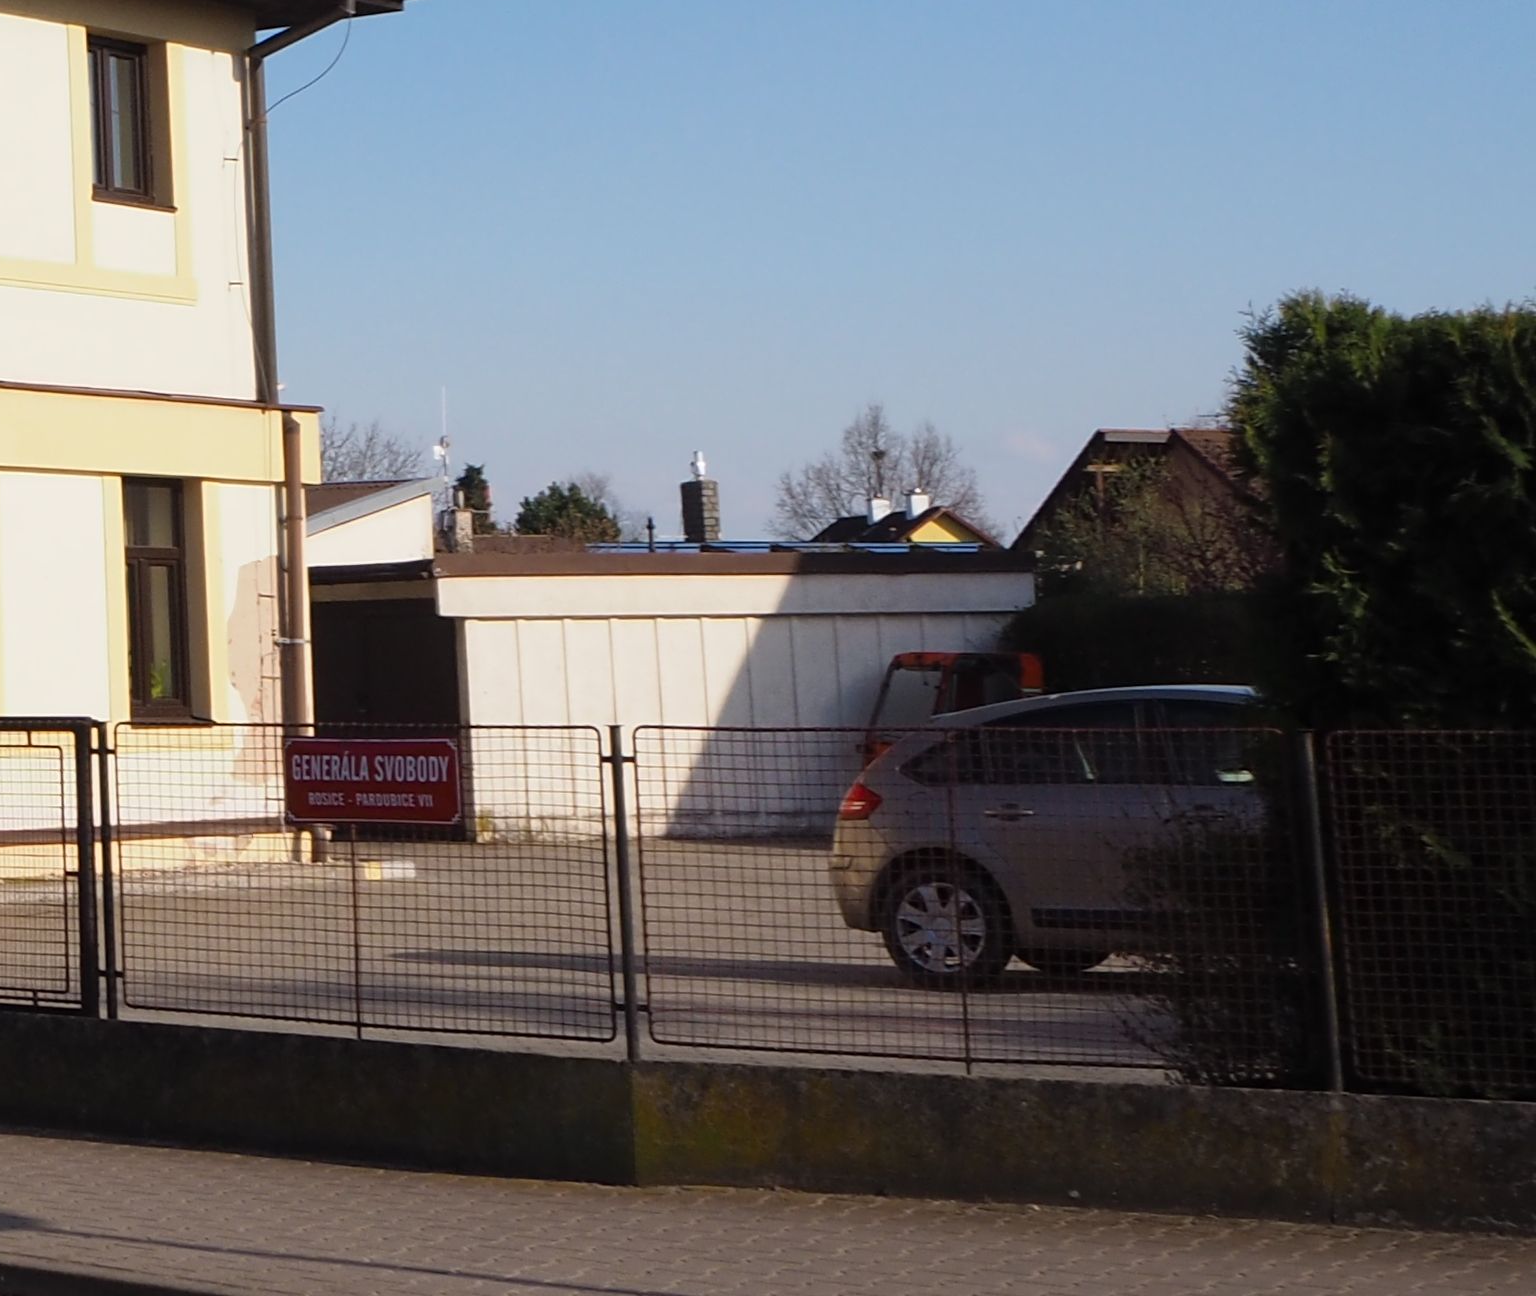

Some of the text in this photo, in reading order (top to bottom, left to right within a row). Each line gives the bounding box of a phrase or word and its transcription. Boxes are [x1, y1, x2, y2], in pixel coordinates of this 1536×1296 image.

[292, 750, 449, 782] GENERÁLA SVOBODY
[308, 791, 345, 806] ROSICE
[355, 792, 415, 807] PARDUBICE
[418, 794, 433, 807] VII
